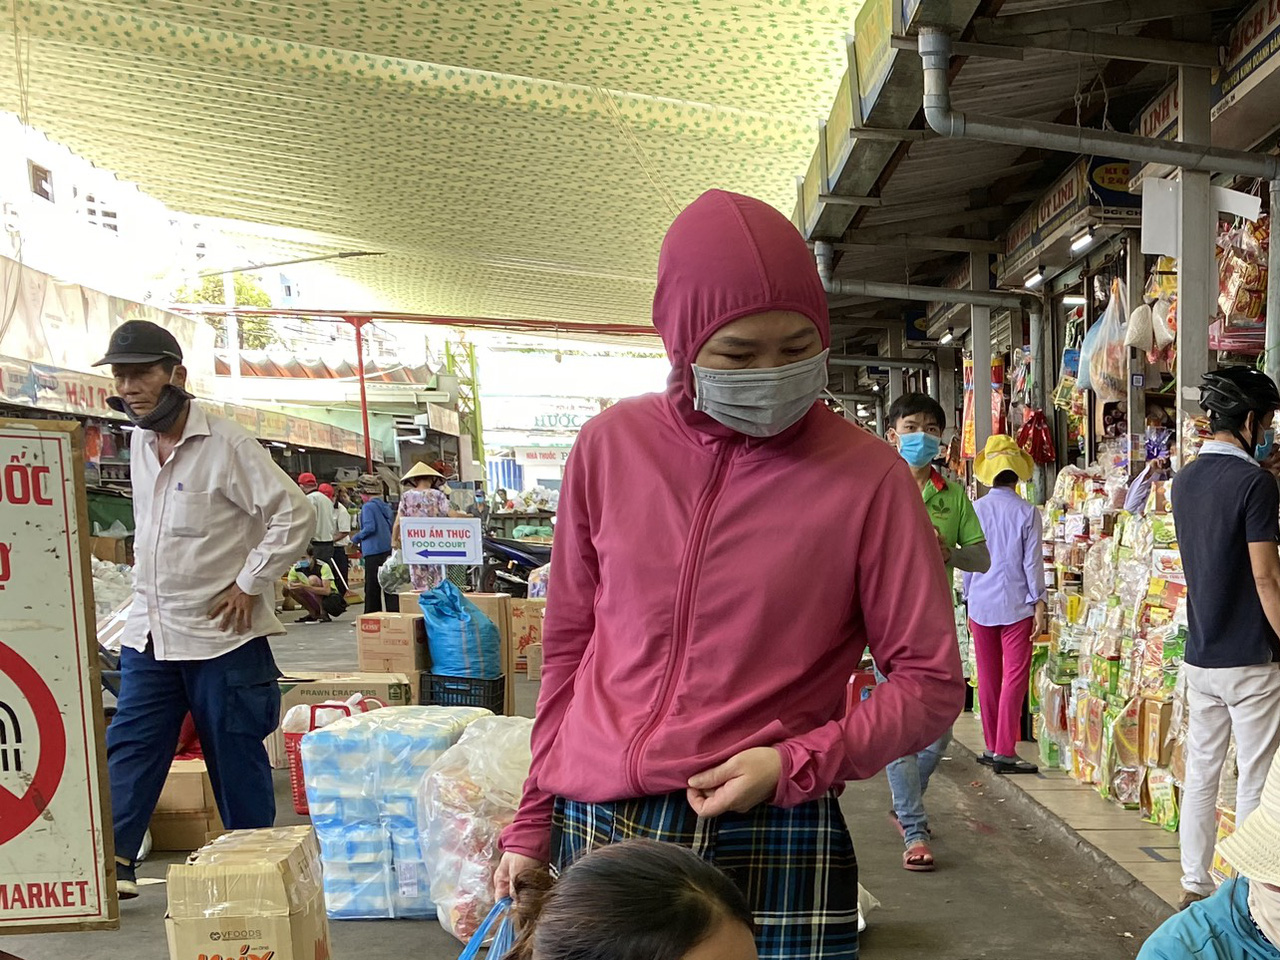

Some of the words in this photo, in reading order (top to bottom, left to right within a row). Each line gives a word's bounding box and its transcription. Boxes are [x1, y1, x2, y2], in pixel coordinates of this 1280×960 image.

[0, 451, 53, 506] ỐC
[407, 530, 426, 539] KHU
[300, 689, 330, 697] PRAWN
[332, 688, 377, 697] CRACKERS
[221, 929, 262, 938] VFOODS
